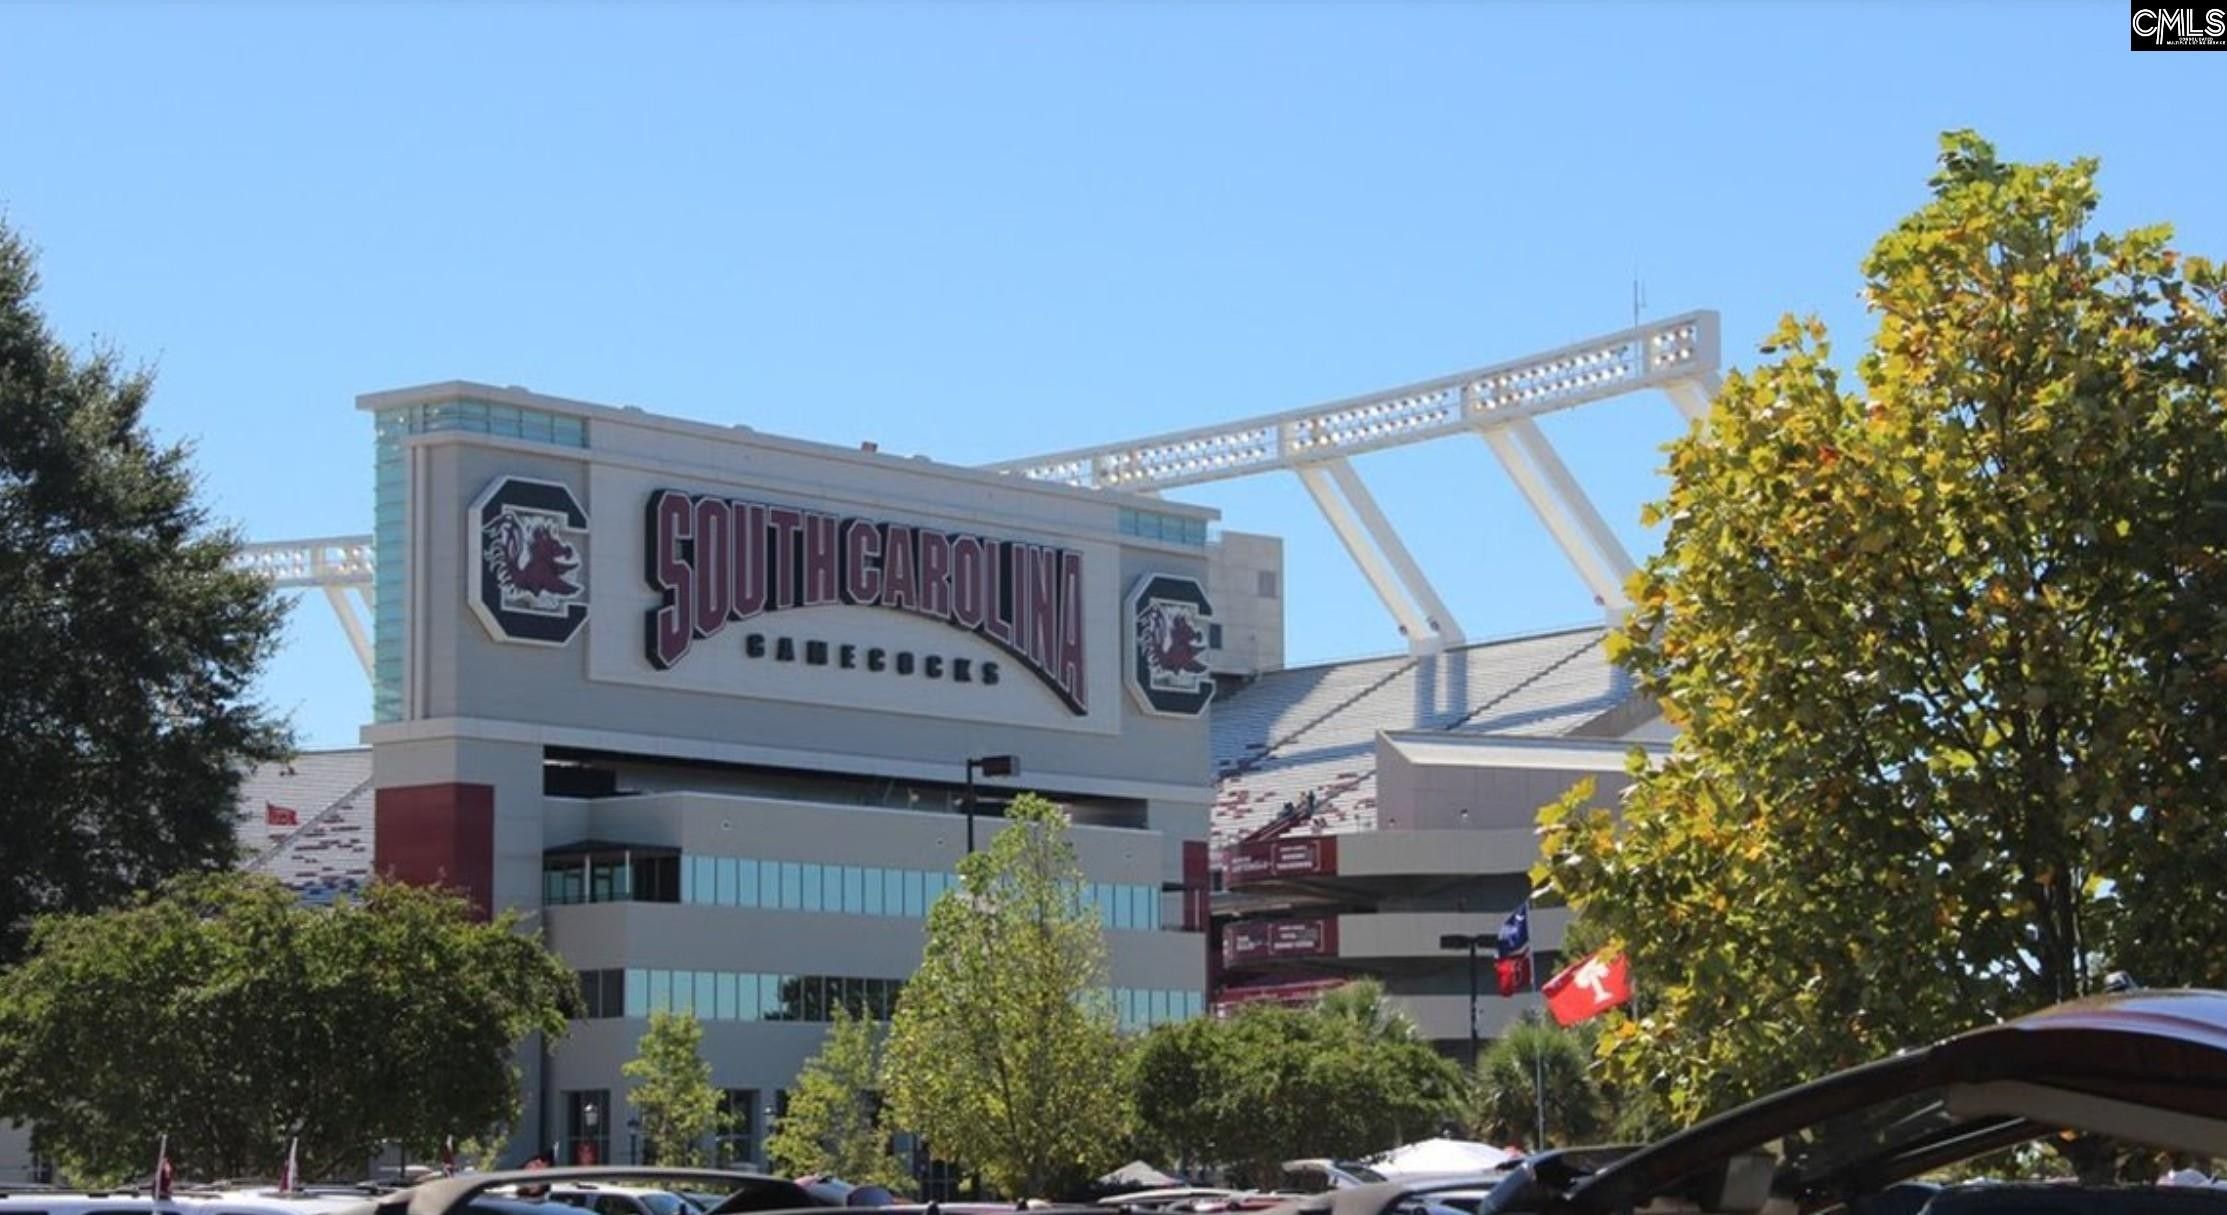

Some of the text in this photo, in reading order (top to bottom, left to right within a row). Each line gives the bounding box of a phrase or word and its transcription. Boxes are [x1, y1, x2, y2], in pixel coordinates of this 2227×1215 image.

[645, 488, 1089, 717] SOUTH CAROLINA
[745, 633, 1000, 686] GAMECOCKS
